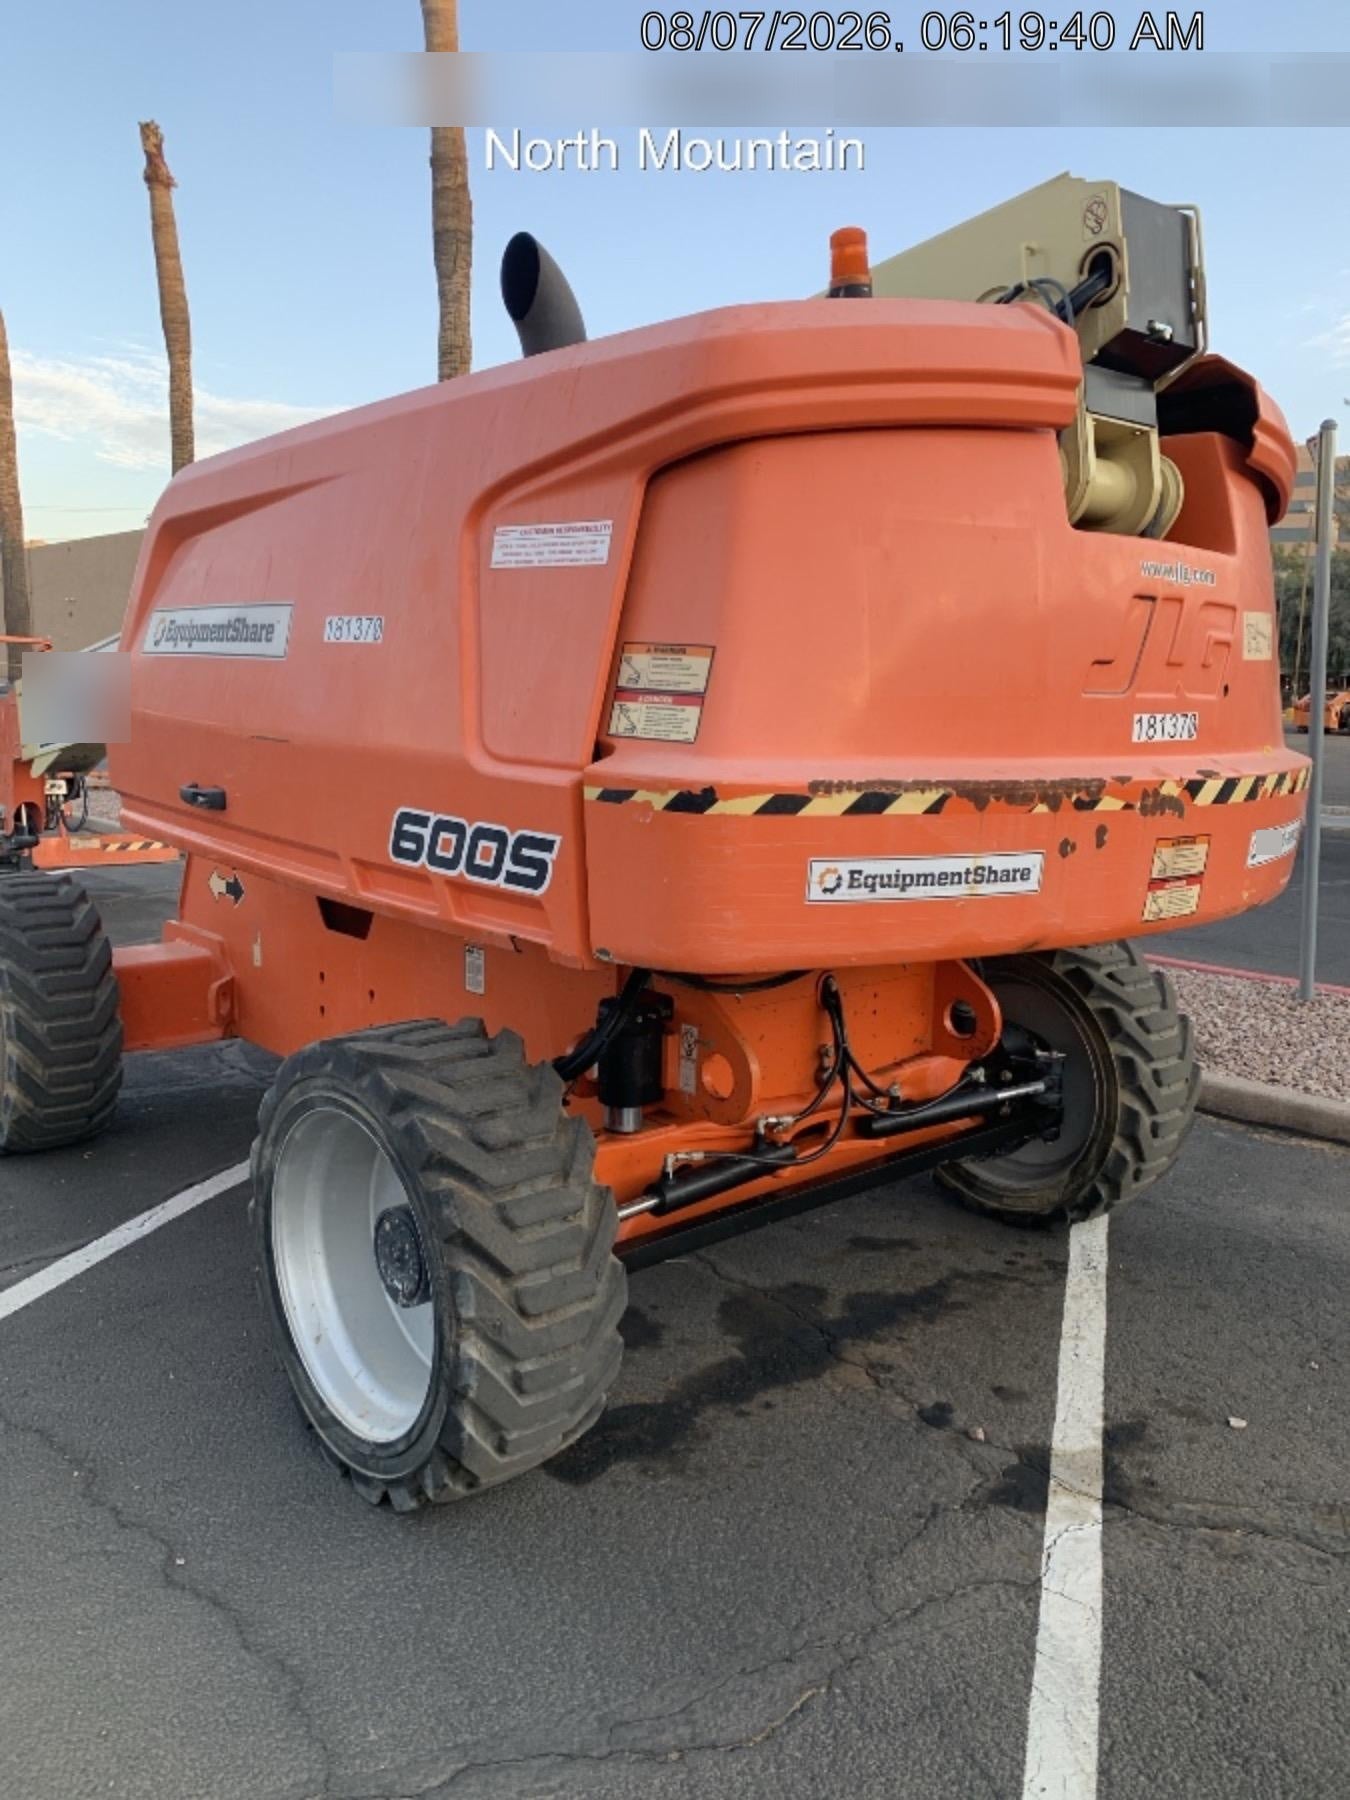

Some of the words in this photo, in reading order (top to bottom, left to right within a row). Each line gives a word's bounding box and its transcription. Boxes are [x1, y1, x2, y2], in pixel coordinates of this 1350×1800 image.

[1142, 561, 1215, 585] www.jlg.com
[164, 617, 275, 648] EquipmentShare
[1082, 594, 1237, 700] JLG
[391, 809, 559, 893] 600S
[847, 865, 1031, 892] EquipmentShare
